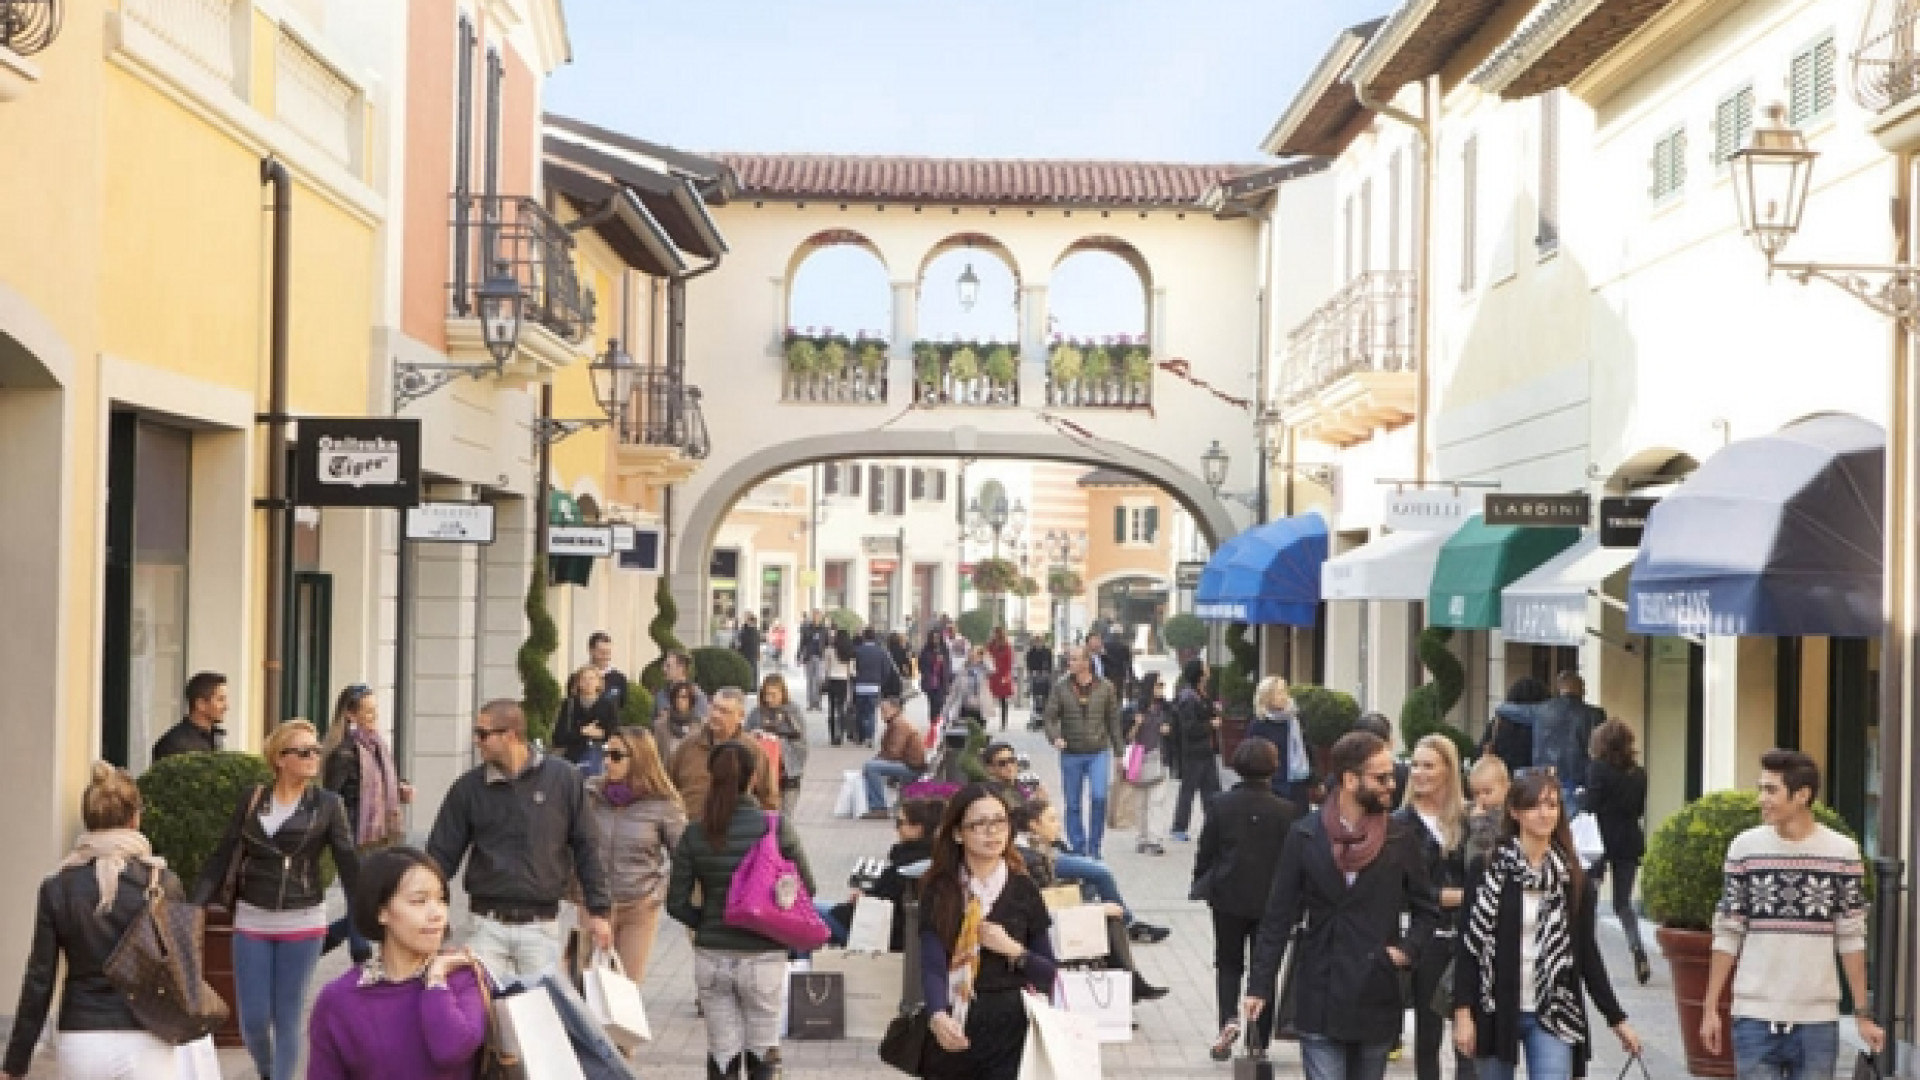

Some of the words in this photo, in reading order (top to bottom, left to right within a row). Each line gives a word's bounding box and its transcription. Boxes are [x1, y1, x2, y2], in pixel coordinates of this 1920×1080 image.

[328, 455, 389, 478] Tiger
[1492, 501, 1582, 516] LARDINI
[551, 534, 606, 547] DIESEL
